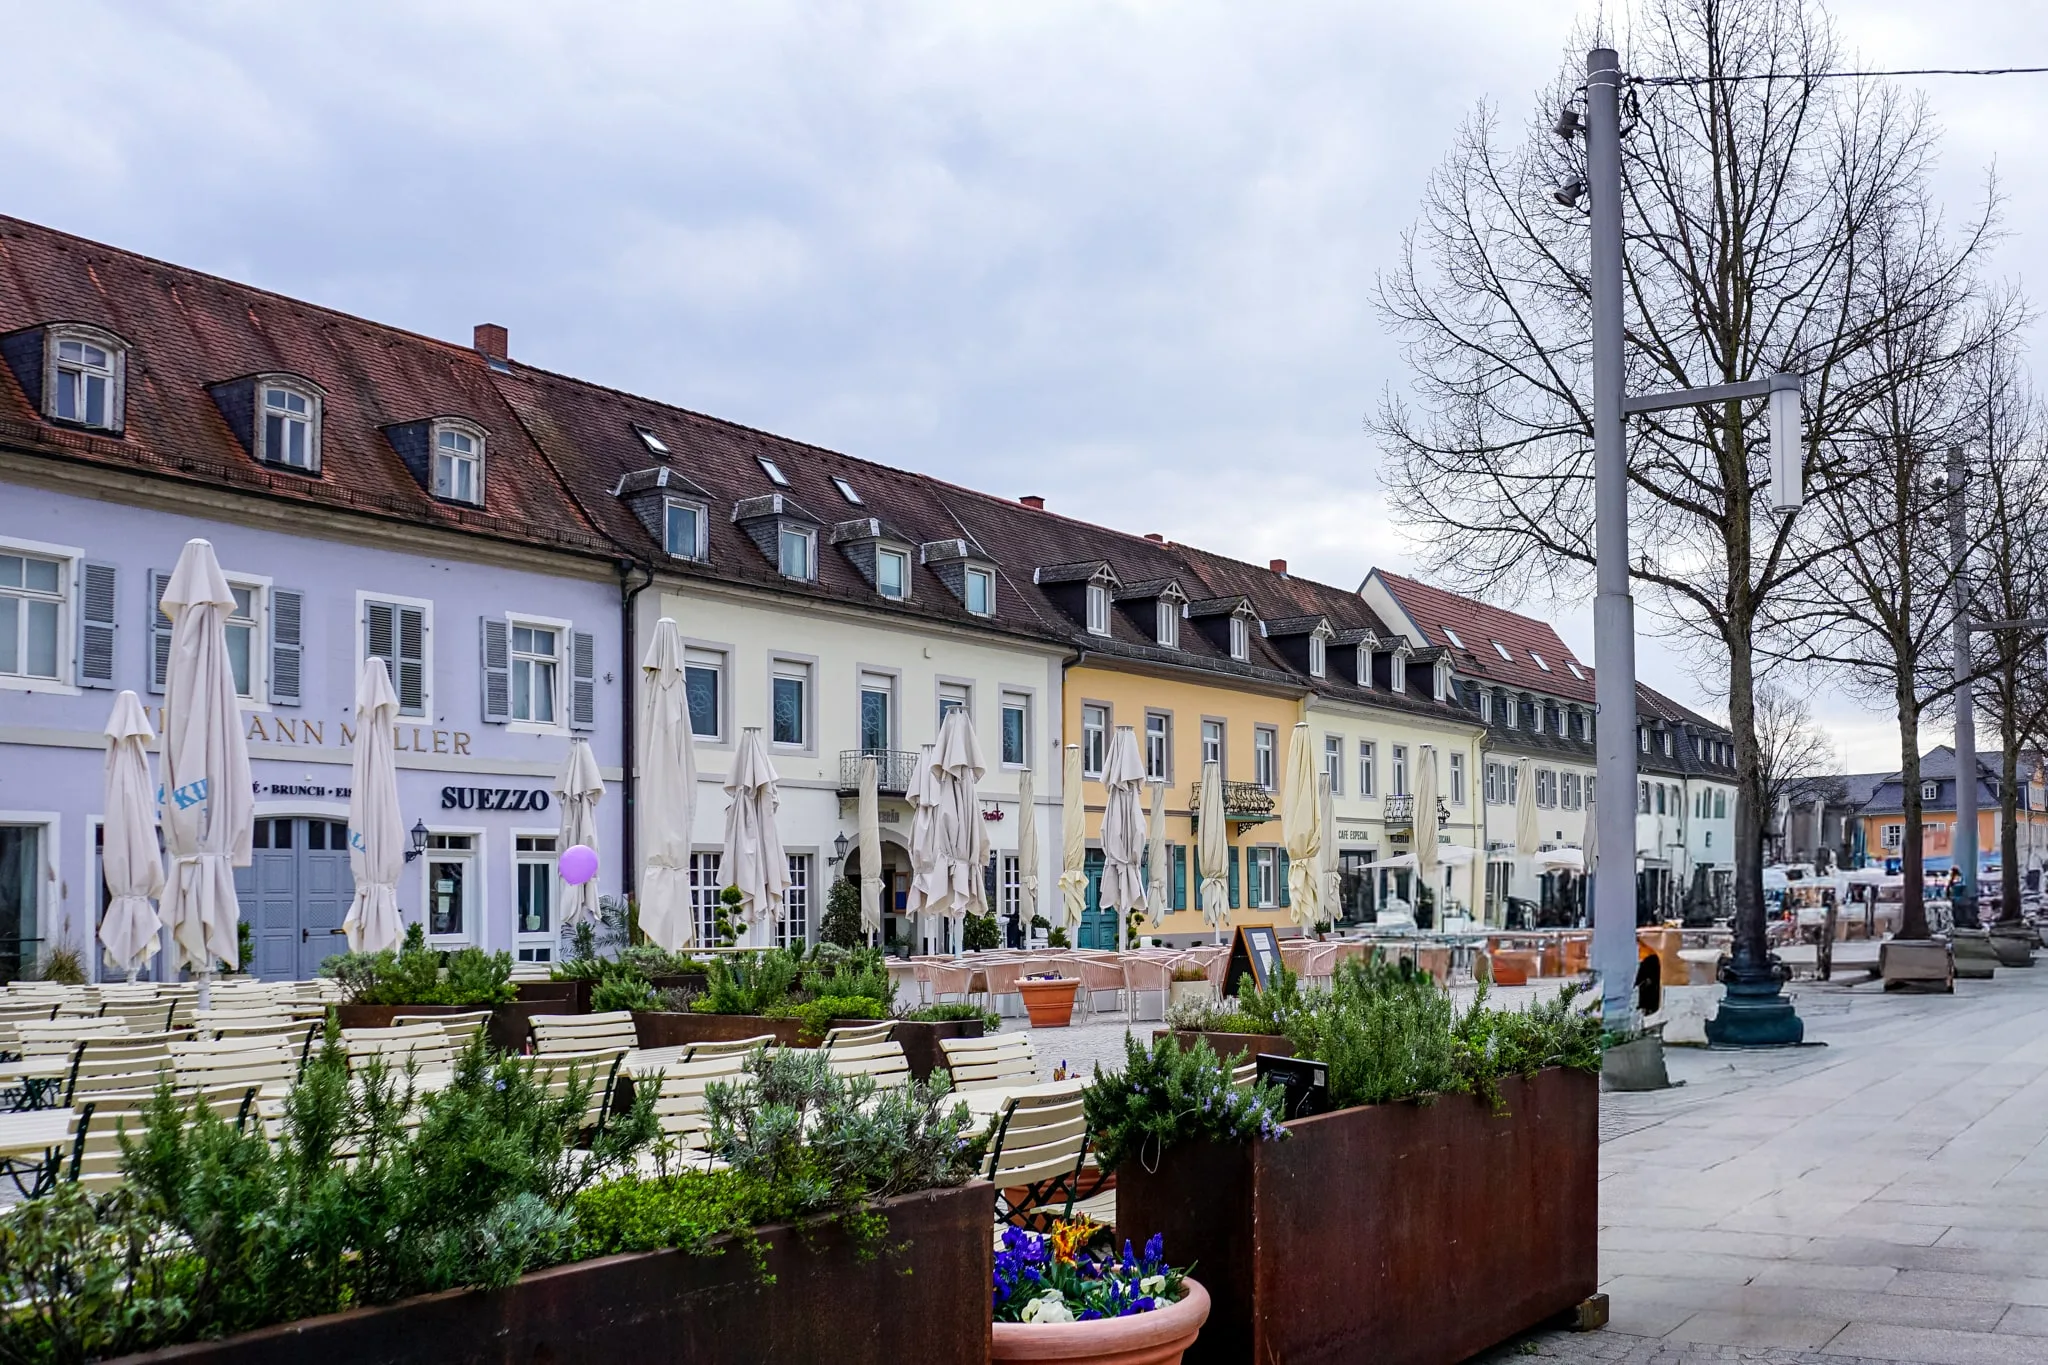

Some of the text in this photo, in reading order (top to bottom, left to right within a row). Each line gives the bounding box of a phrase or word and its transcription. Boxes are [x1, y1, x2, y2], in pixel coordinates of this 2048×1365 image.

[340, 722, 471, 756] MLLER
[271, 784, 325, 797] BRUNCH
[441, 786, 550, 811] SUEZZO
